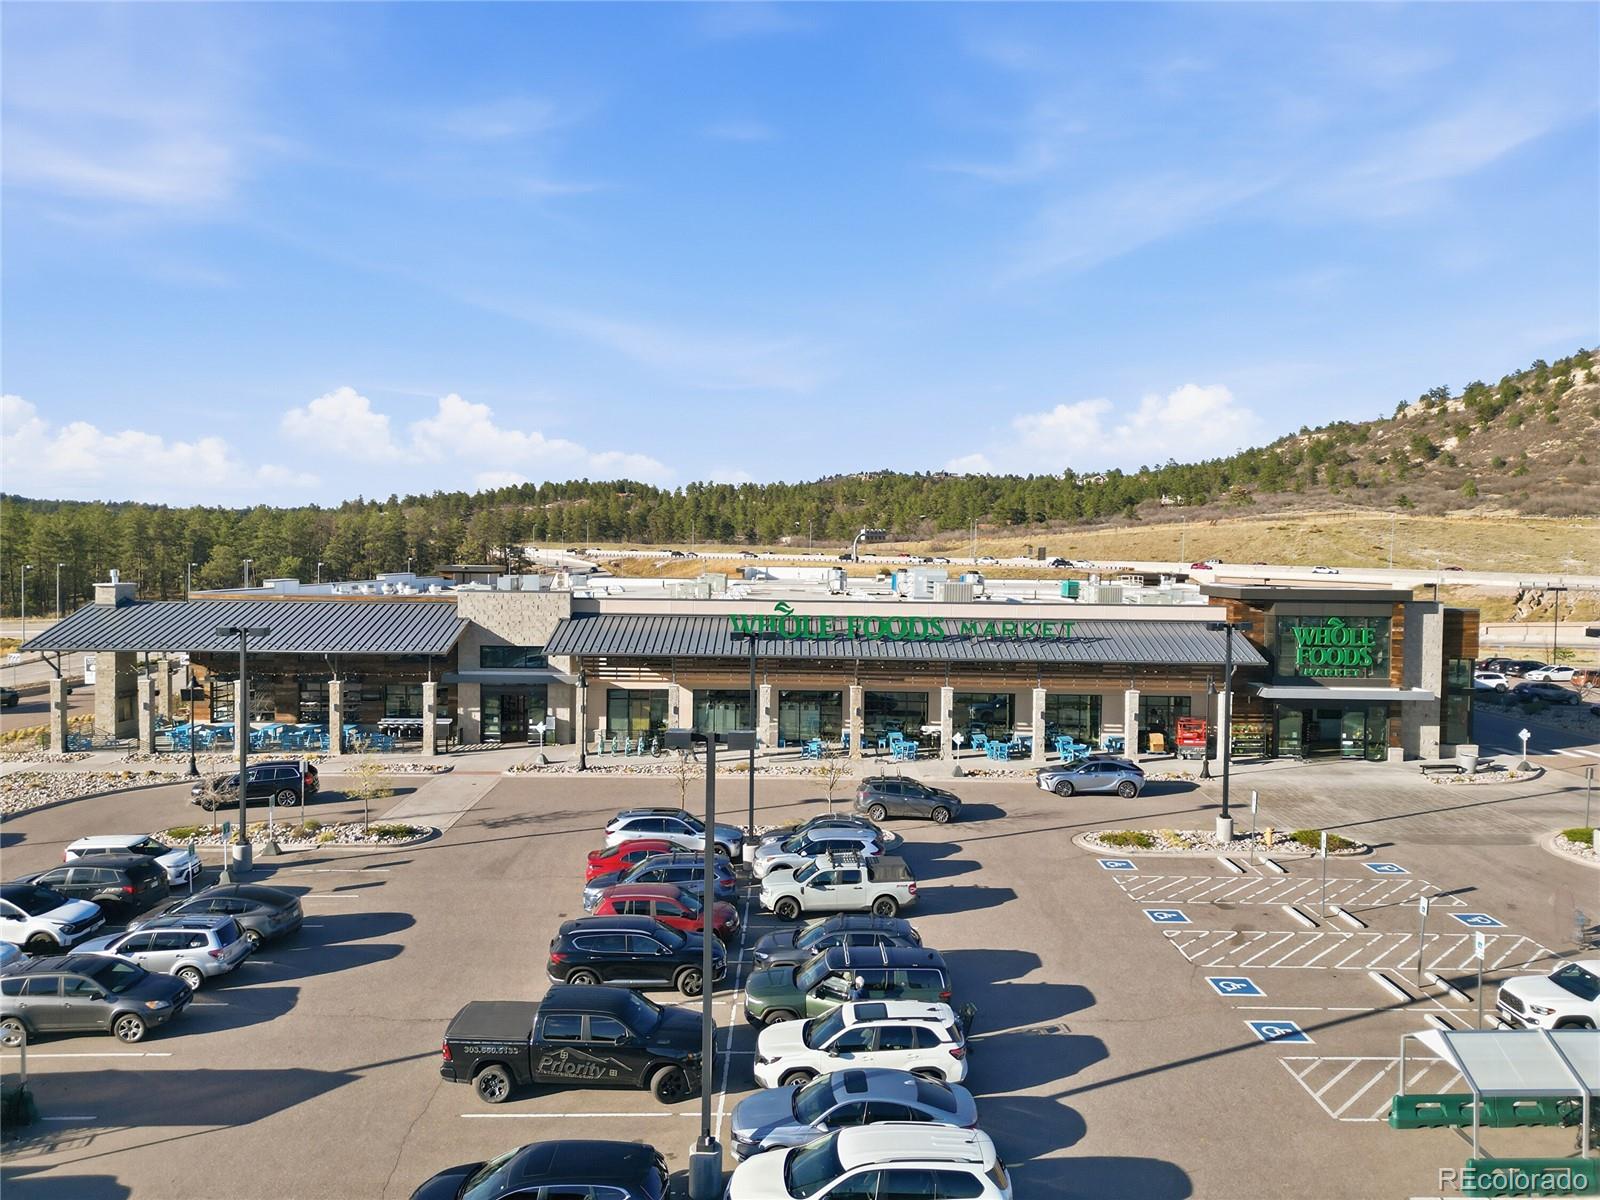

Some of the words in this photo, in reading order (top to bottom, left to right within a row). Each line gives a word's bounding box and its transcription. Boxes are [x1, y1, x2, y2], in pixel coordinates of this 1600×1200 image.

[729, 614, 838, 640] WHOLE
[847, 616, 945, 641] FOODS
[960, 621, 1076, 638] MARKET
[1293, 626, 1376, 647] WHOLE
[1295, 647, 1373, 667] FOODS
[1303, 668, 1360, 677] MARKET
[537, 1054, 606, 1079] Priority
